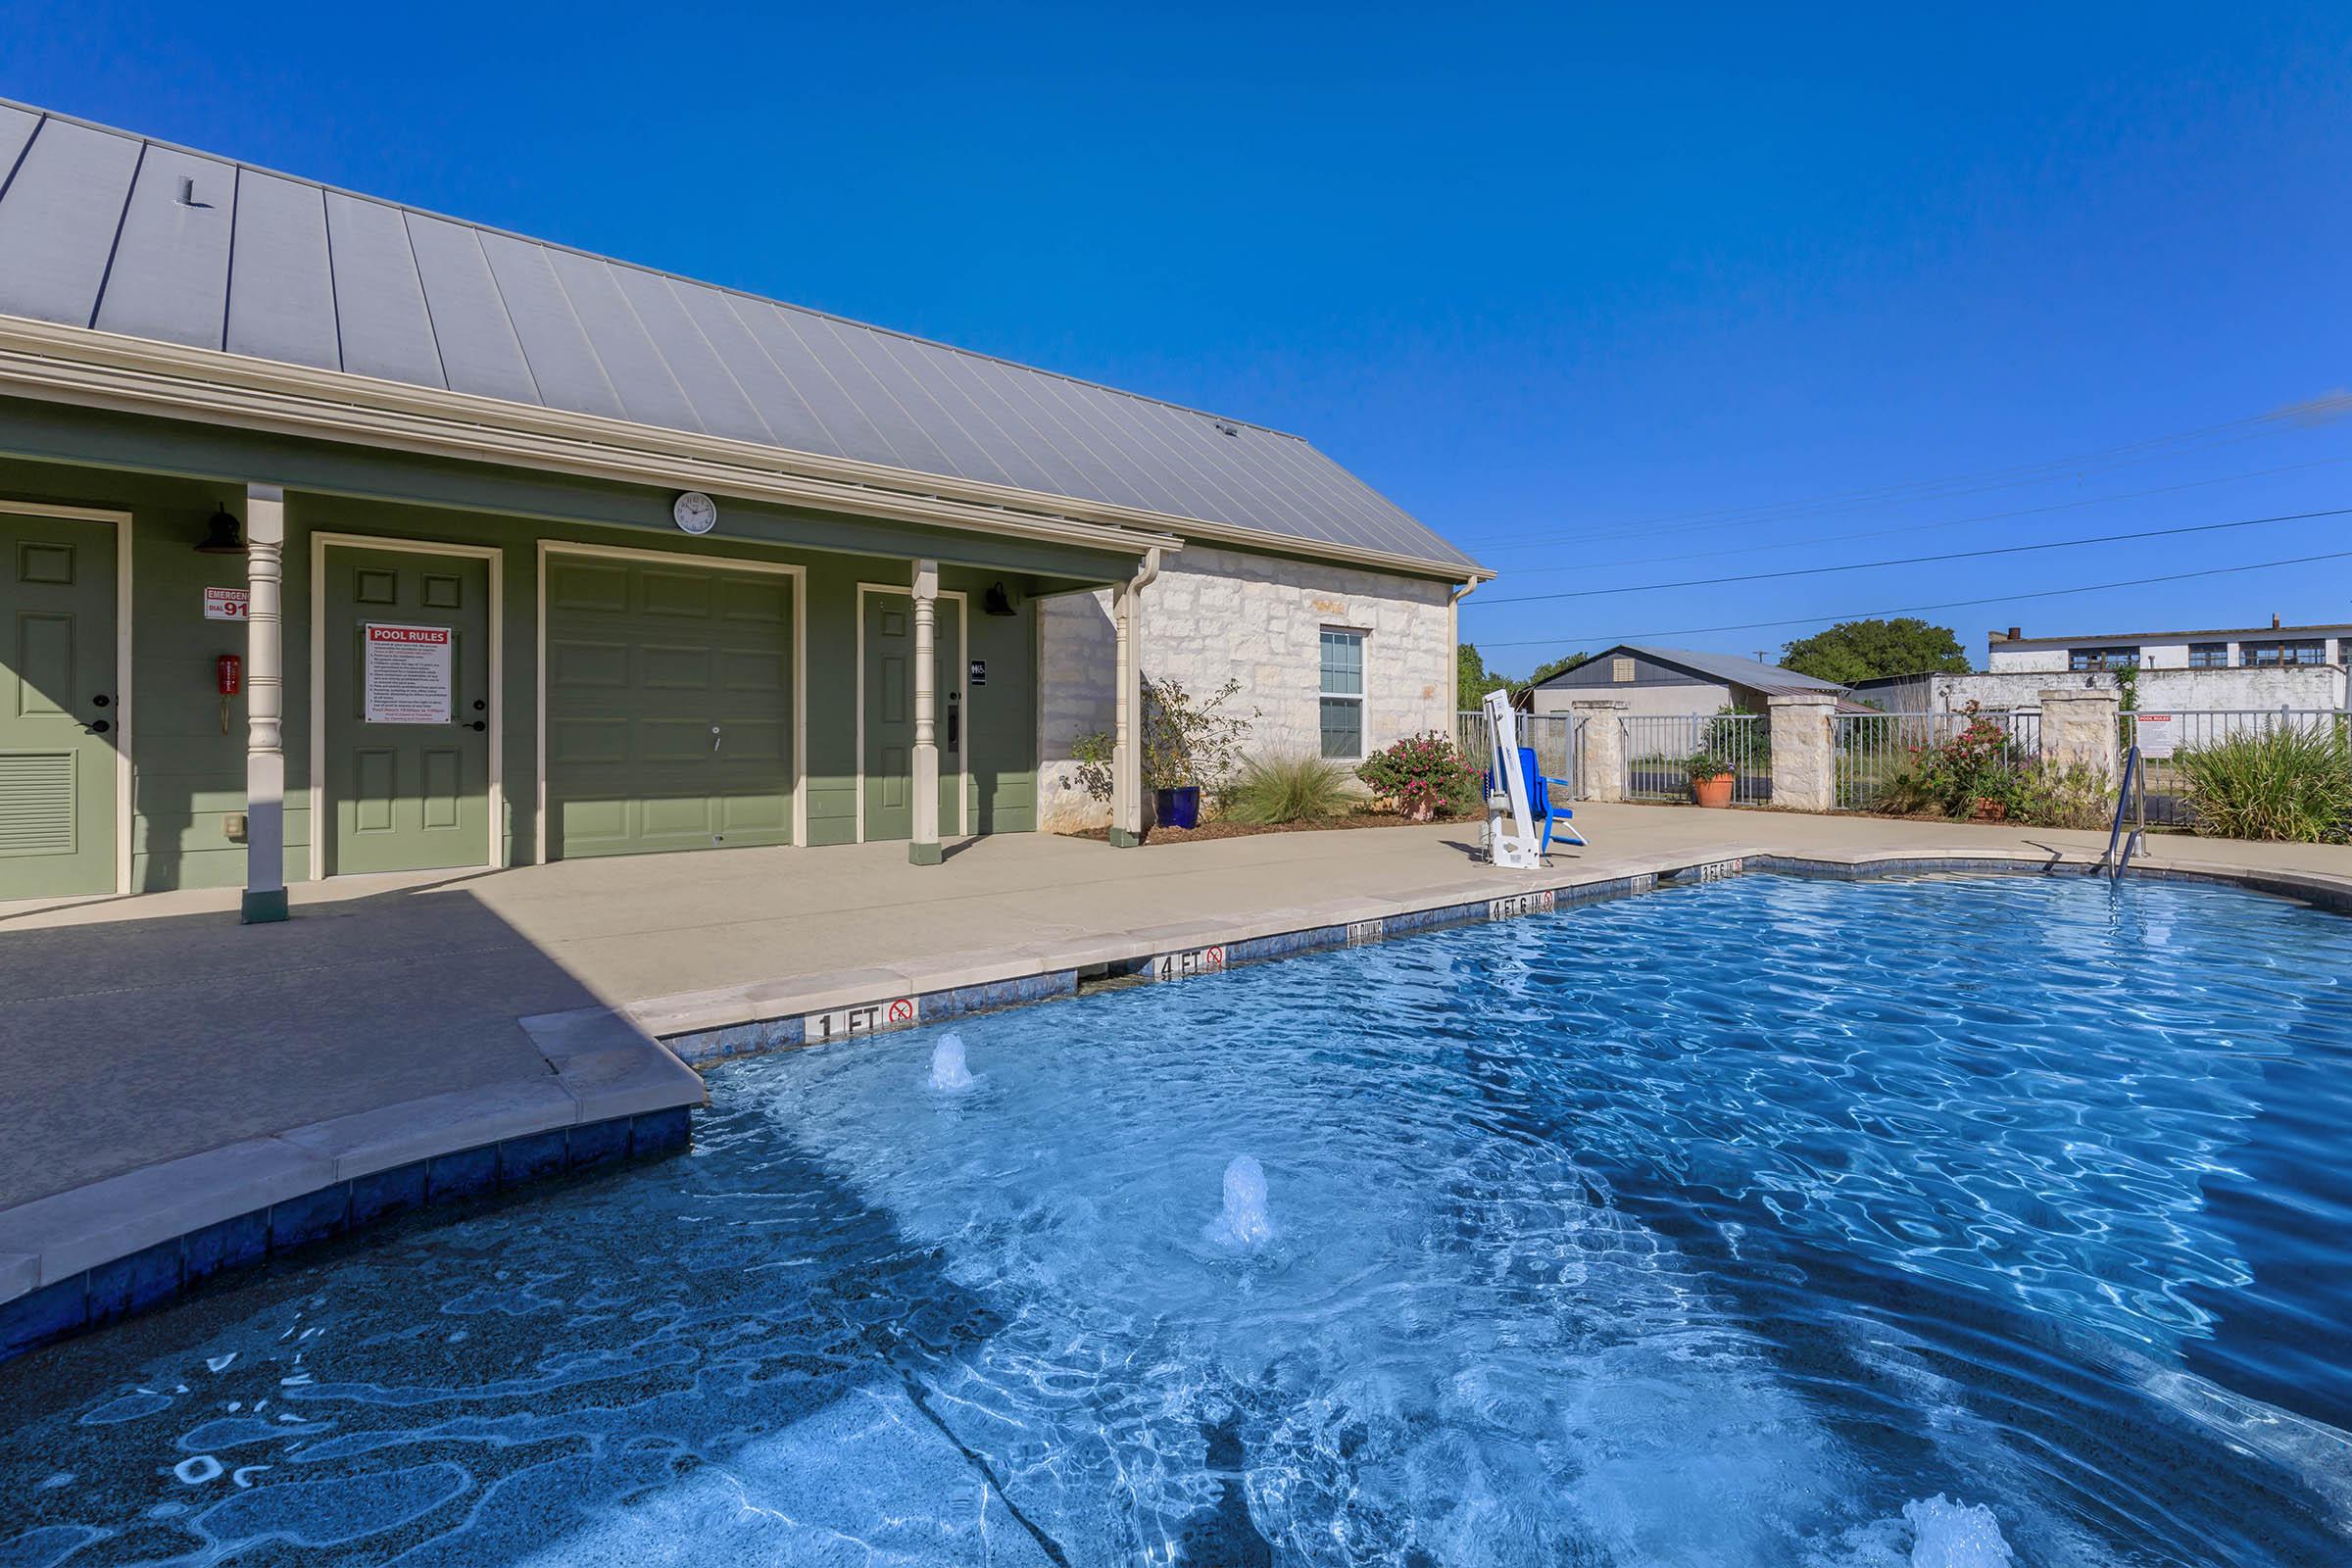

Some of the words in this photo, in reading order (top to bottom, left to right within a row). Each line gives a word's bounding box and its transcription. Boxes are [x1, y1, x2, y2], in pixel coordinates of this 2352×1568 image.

[208, 590, 251, 600] EMERGENC
[224, 602, 249, 617] 91
[374, 630, 407, 640] POOL
[409, 632, 444, 642] RULES
[1494, 901, 1499, 915] 4
[1505, 899, 1515, 913] FT
[1161, 956, 1173, 974] 4
[1182, 951, 1200, 974] FT
[819, 1014, 830, 1037] 1
[849, 1005, 879, 1035] FT
